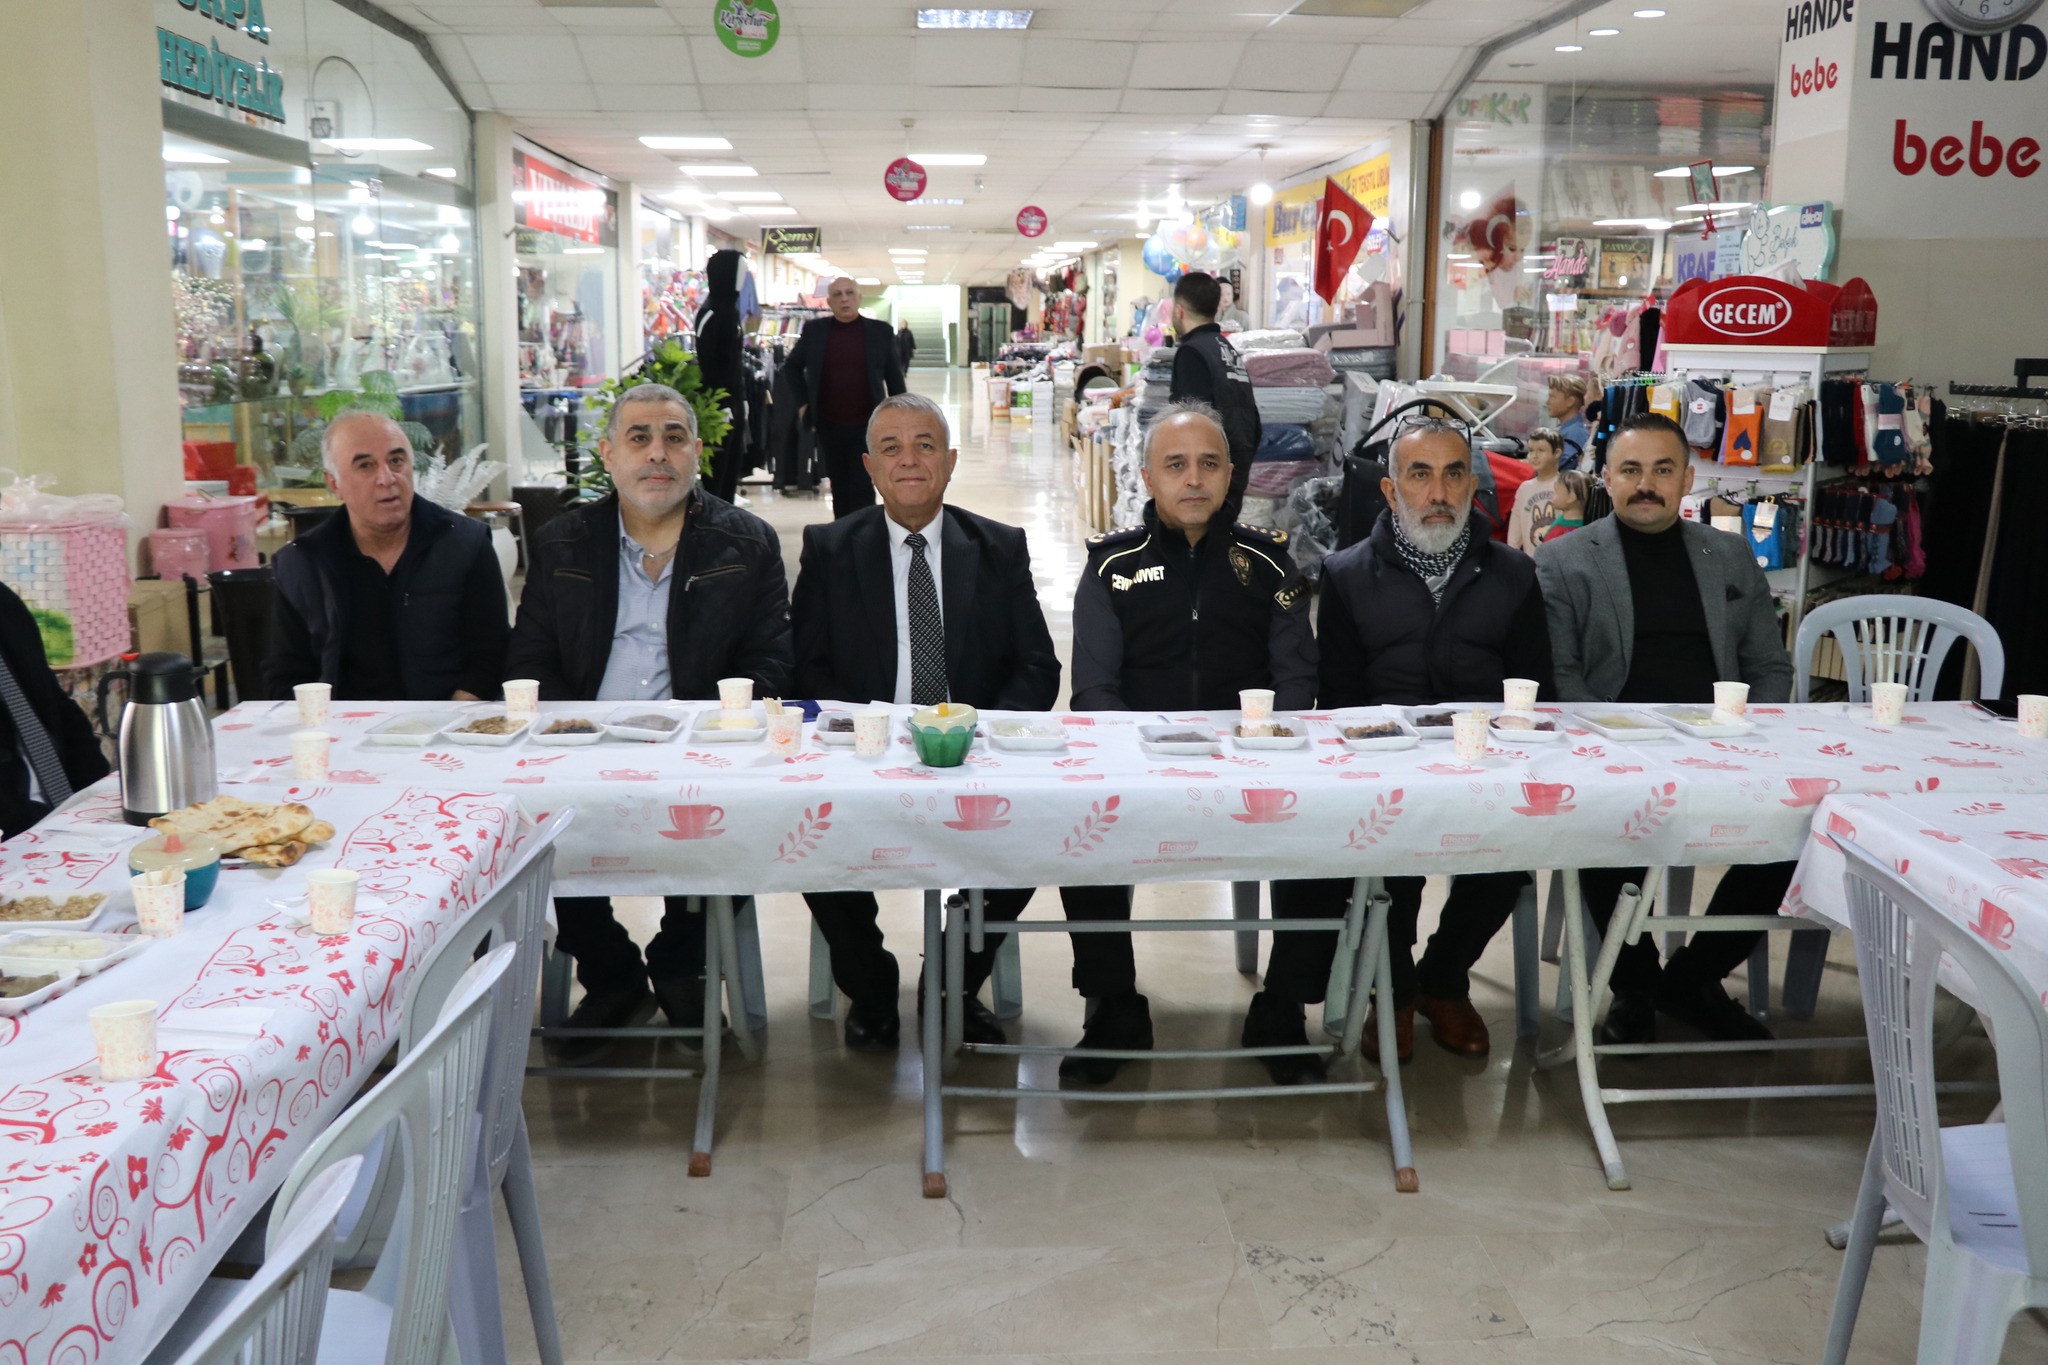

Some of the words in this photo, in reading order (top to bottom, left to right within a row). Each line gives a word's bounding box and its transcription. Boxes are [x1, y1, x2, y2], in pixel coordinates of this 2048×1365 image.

[156, 25, 286, 124] HEDİYELİK
[1790, 57, 1838, 98] bebe
[1893, 119, 2041, 178] bebe
[1543, 248, 1589, 280] Hande
[1677, 250, 1723, 284] KRAF
[1709, 303, 1777, 325] GECEM
